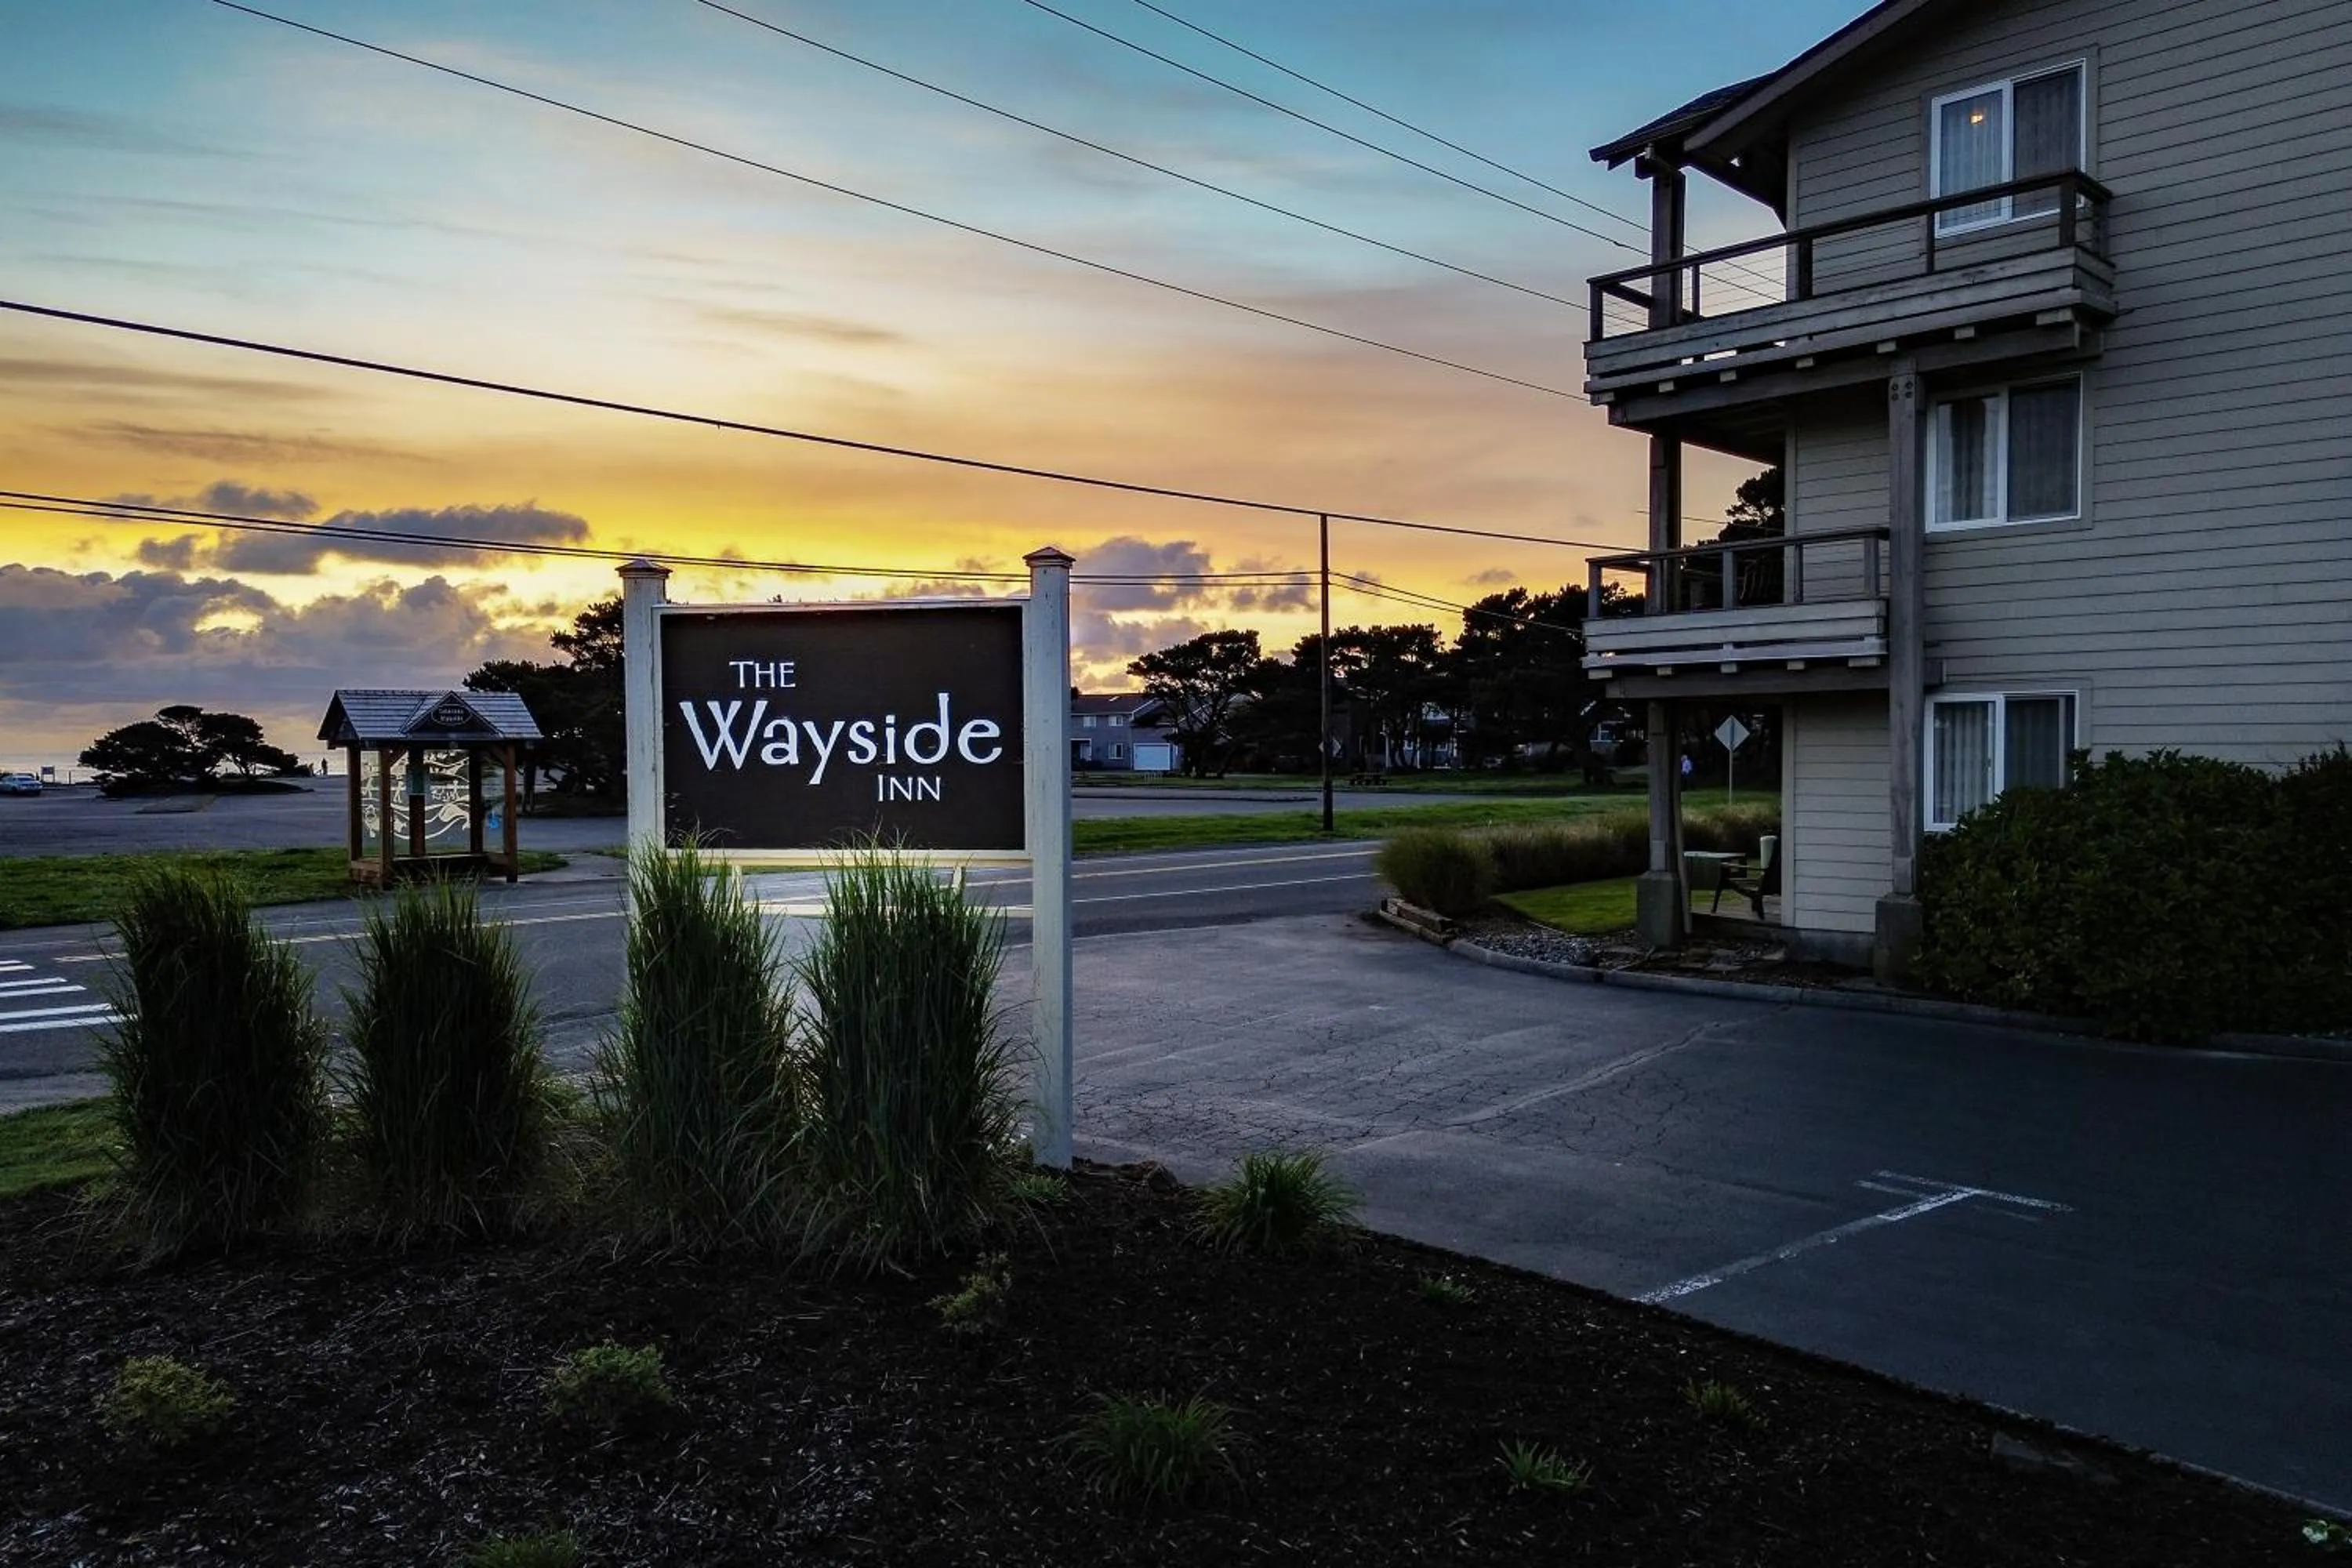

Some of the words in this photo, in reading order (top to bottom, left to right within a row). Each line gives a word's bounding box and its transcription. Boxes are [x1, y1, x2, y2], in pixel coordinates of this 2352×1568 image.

[728, 661, 796, 688] THE
[679, 692, 1003, 785] Wayside
[877, 775, 942, 802] INN
